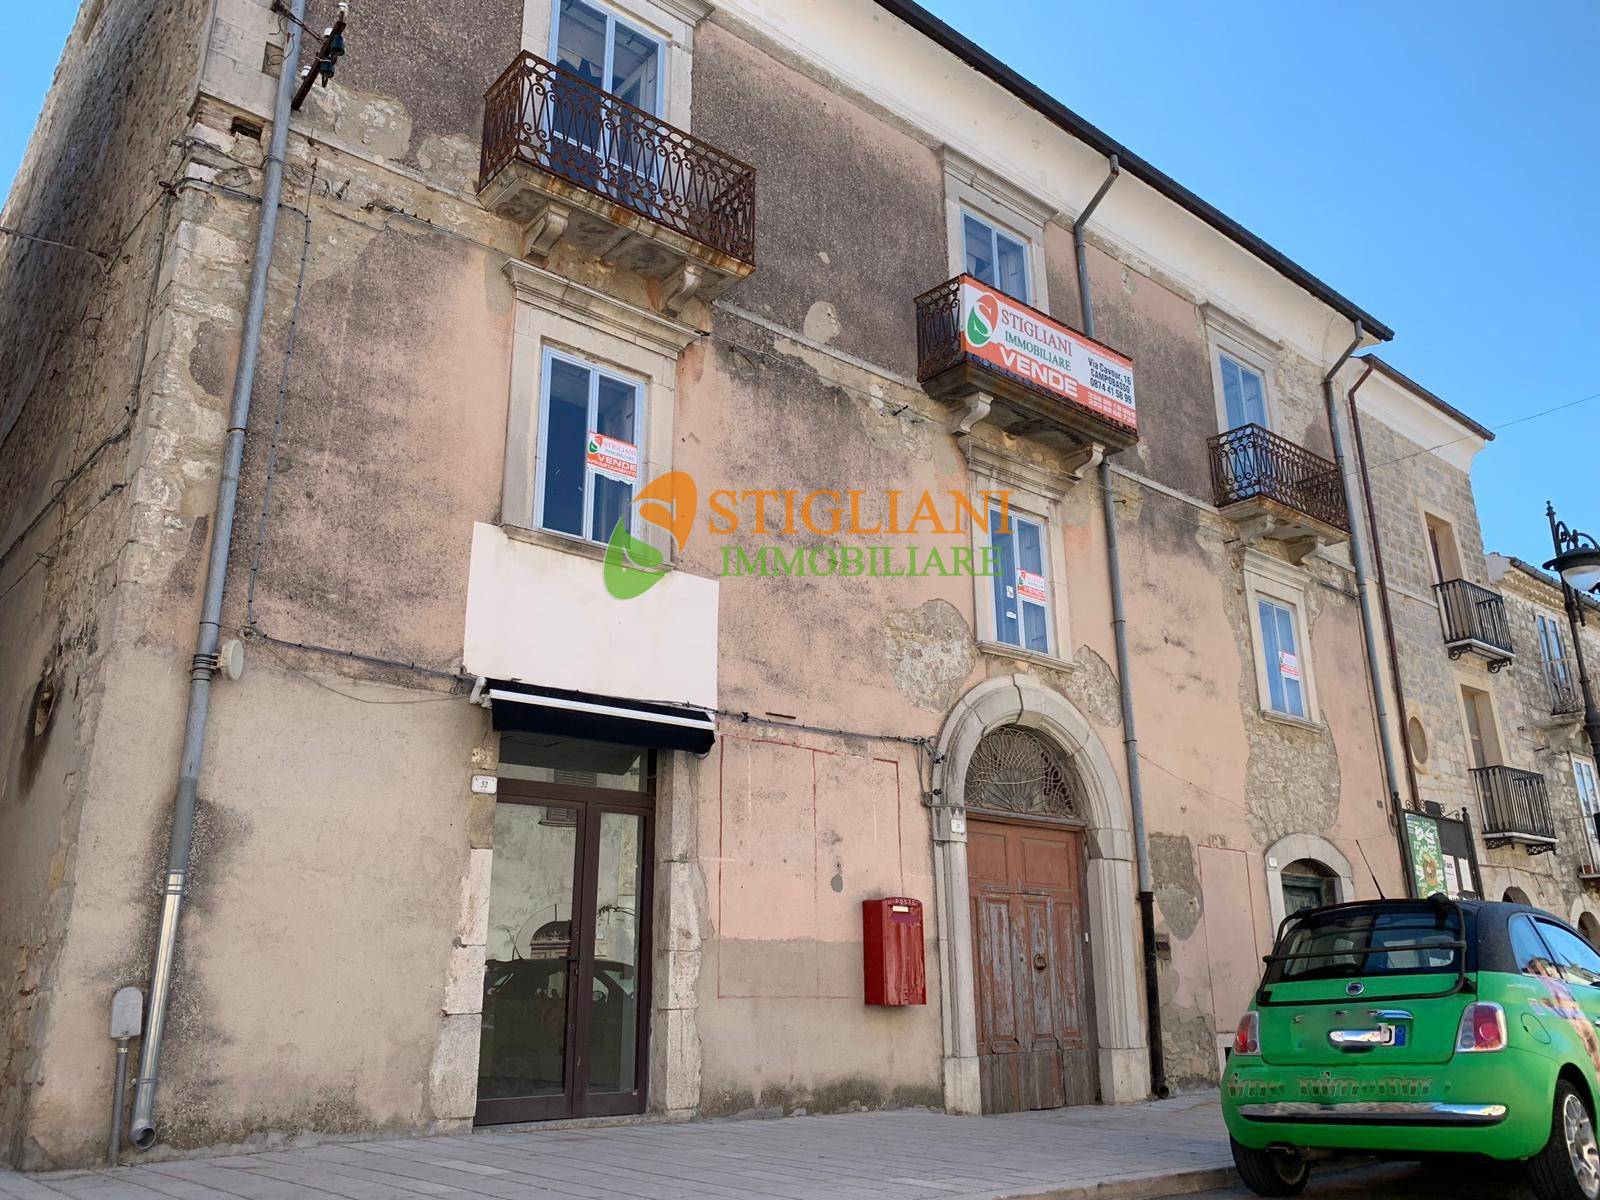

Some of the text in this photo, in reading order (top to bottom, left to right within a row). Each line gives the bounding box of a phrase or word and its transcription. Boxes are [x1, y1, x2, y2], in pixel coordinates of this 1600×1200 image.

[1001, 309, 1073, 357] STIGLIANI
[1005, 330, 1072, 372] IMMOBILIARE
[1000, 347, 1078, 399] VENDE
[1088, 357, 1099, 370] Via
[1123, 375, 1132, 386] 16
[1090, 368, 1131, 394] CAMPOBASSO
[1090, 377, 1106, 392] 0874
[1107, 385, 1114, 396] 41
[1115, 389, 1124, 401] 58
[1124, 393, 1132, 405] 99
[598, 455, 637, 471] VENDE
